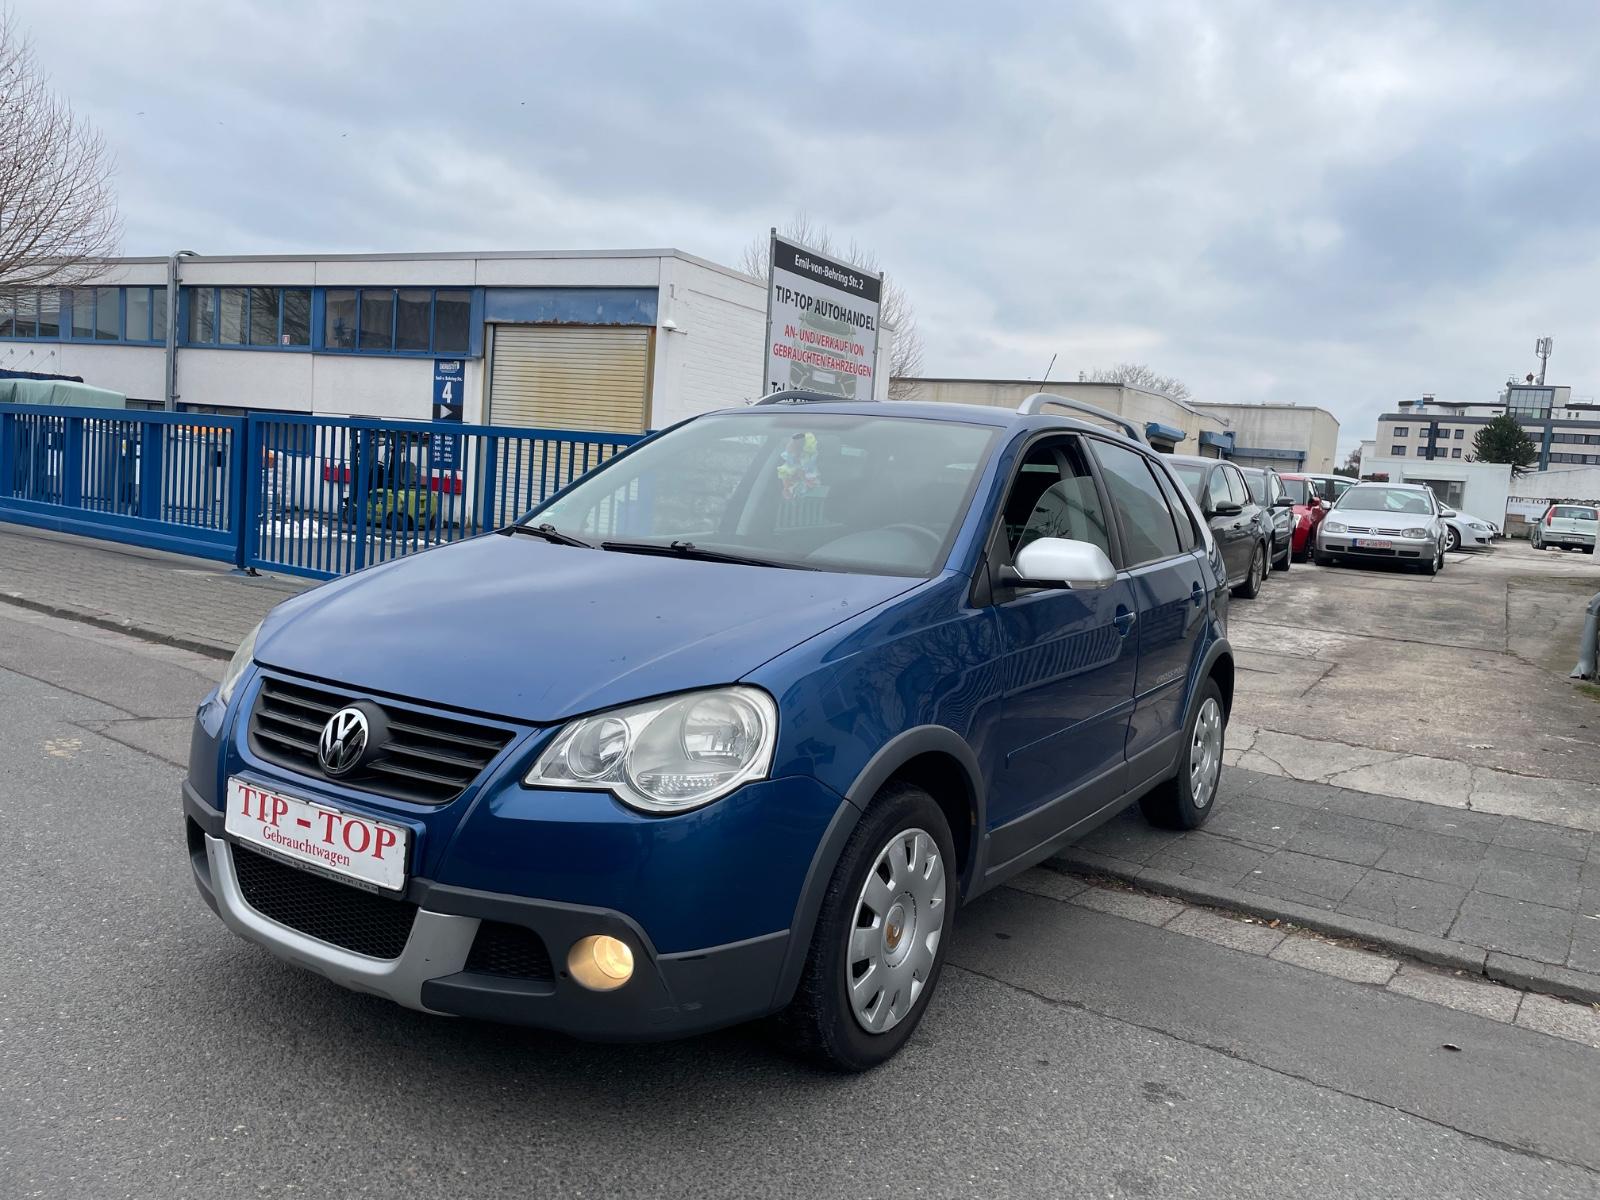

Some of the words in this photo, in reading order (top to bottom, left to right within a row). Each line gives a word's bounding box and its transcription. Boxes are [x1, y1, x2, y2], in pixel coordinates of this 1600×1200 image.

[794, 254, 848, 287] Emil-von-Behring
[849, 275, 859, 288] Str.
[859, 279, 864, 290] 2
[775, 285, 813, 311] TIP-TOP
[814, 299, 875, 331] AUTOHANDEL
[784, 324, 798, 337] AN-
[799, 329, 815, 344] UND
[815, 333, 848, 352] VERKAUF
[849, 342, 865, 357] VON
[773, 343, 825, 366] GEBRAUCHTEN
[826, 359, 872, 377] FAHRZEUGEN
[442, 381, 452, 403] 4
[238, 785, 289, 827] TIP
[318, 811, 396, 860] TOP
[262, 826, 350, 867] Gebrauchtwagen
